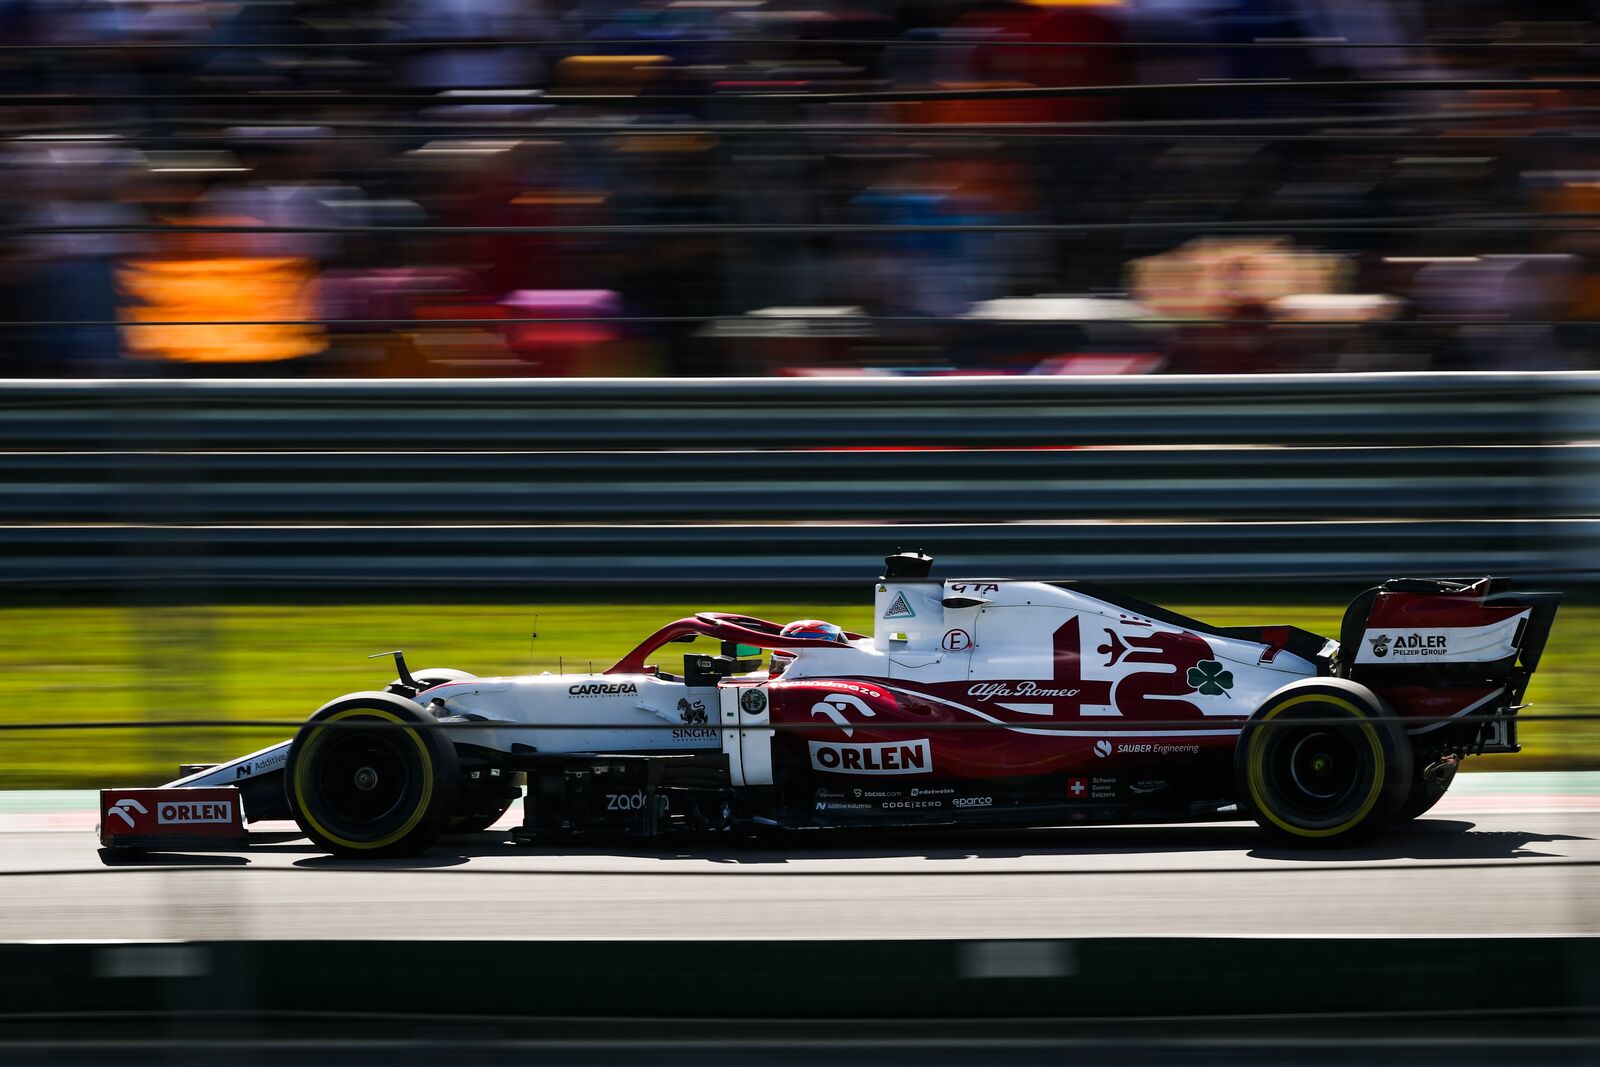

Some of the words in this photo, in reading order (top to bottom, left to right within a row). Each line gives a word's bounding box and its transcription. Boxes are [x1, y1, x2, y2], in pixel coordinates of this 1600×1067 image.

[951, 583, 999, 593] GTA
[950, 632, 961, 650] E
[1393, 634, 1447, 648] ADLER
[1421, 648, 1448, 656] GROUP
[568, 683, 638, 695] CARRERA
[967, 682, 1014, 702] Alfa
[1014, 681, 1081, 697] Romeo
[672, 729, 717, 738] SINGHA
[1117, 744, 1151, 753] SAUBER
[1153, 743, 1199, 754] Engineering
[255, 753, 286, 770] Additive
[816, 744, 925, 770] ORLEN
[952, 796, 992, 808] sparco
[161, 804, 228, 821] ORLEN
